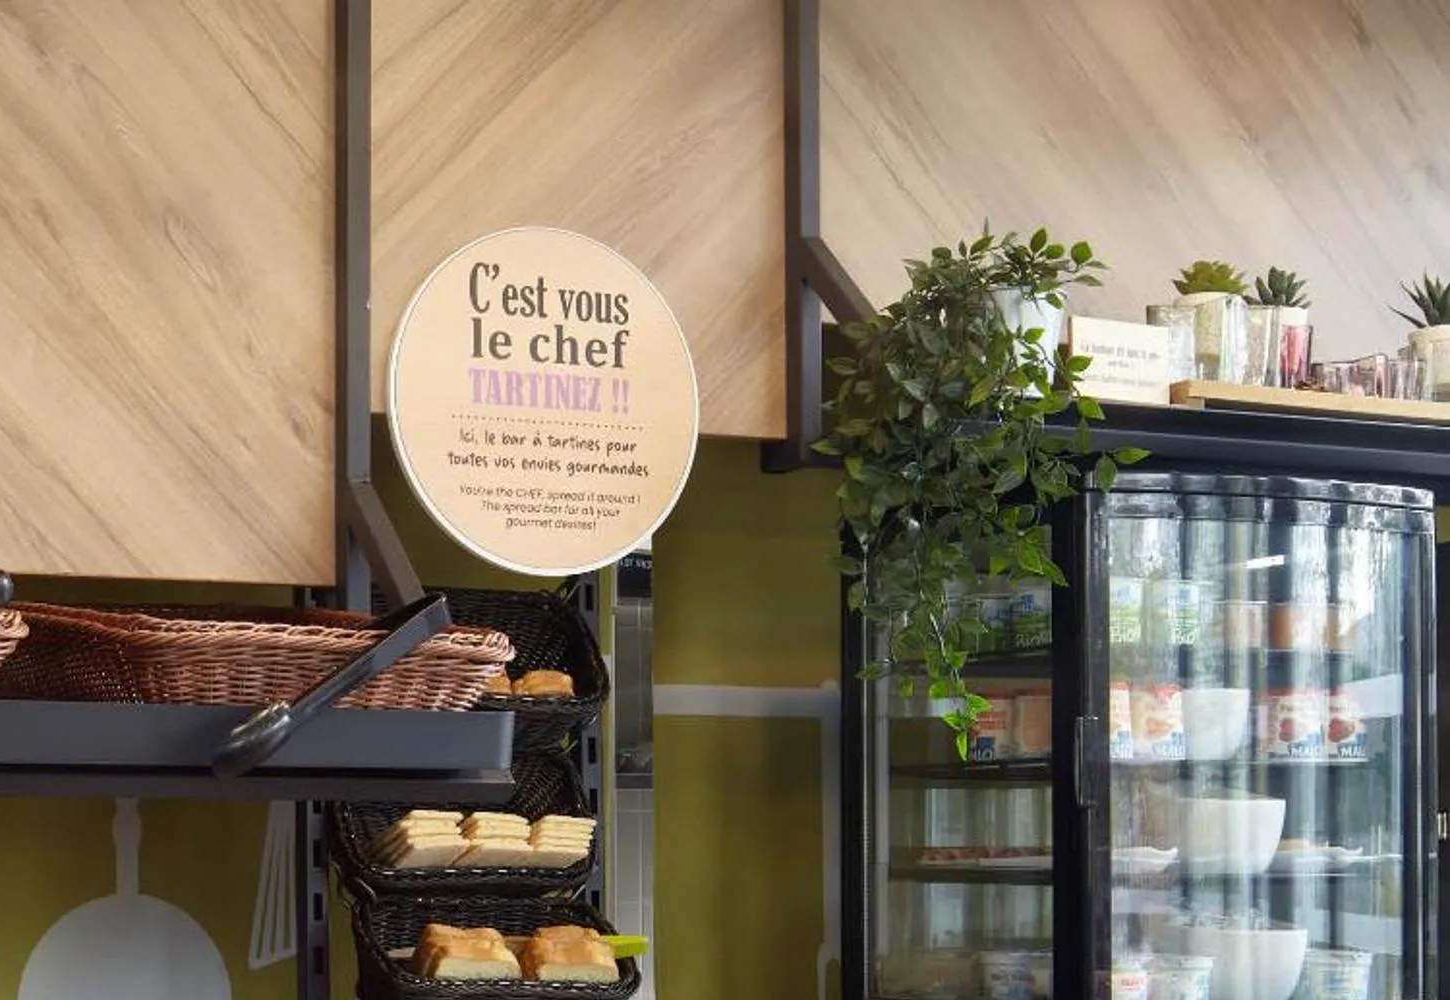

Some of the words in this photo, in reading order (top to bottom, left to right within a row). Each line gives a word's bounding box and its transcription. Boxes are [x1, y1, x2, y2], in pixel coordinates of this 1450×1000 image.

[469, 262, 548, 318] C'est
[558, 289, 629, 325] vous
[471, 317, 512, 360] le
[529, 324, 630, 368] chef
[468, 367, 603, 413] TARTINEZ
[612, 379, 630, 414] !!
[447, 451, 488, 468] toutes
[494, 457, 515, 469] vos
[521, 457, 561, 473] envies
[566, 461, 649, 477] gourmandes
[484, 430, 496, 445] le
[501, 433, 526, 446] bar
[532, 432, 542, 447] à
[547, 433, 600, 451] tartines
[606, 441, 637, 457] pour
